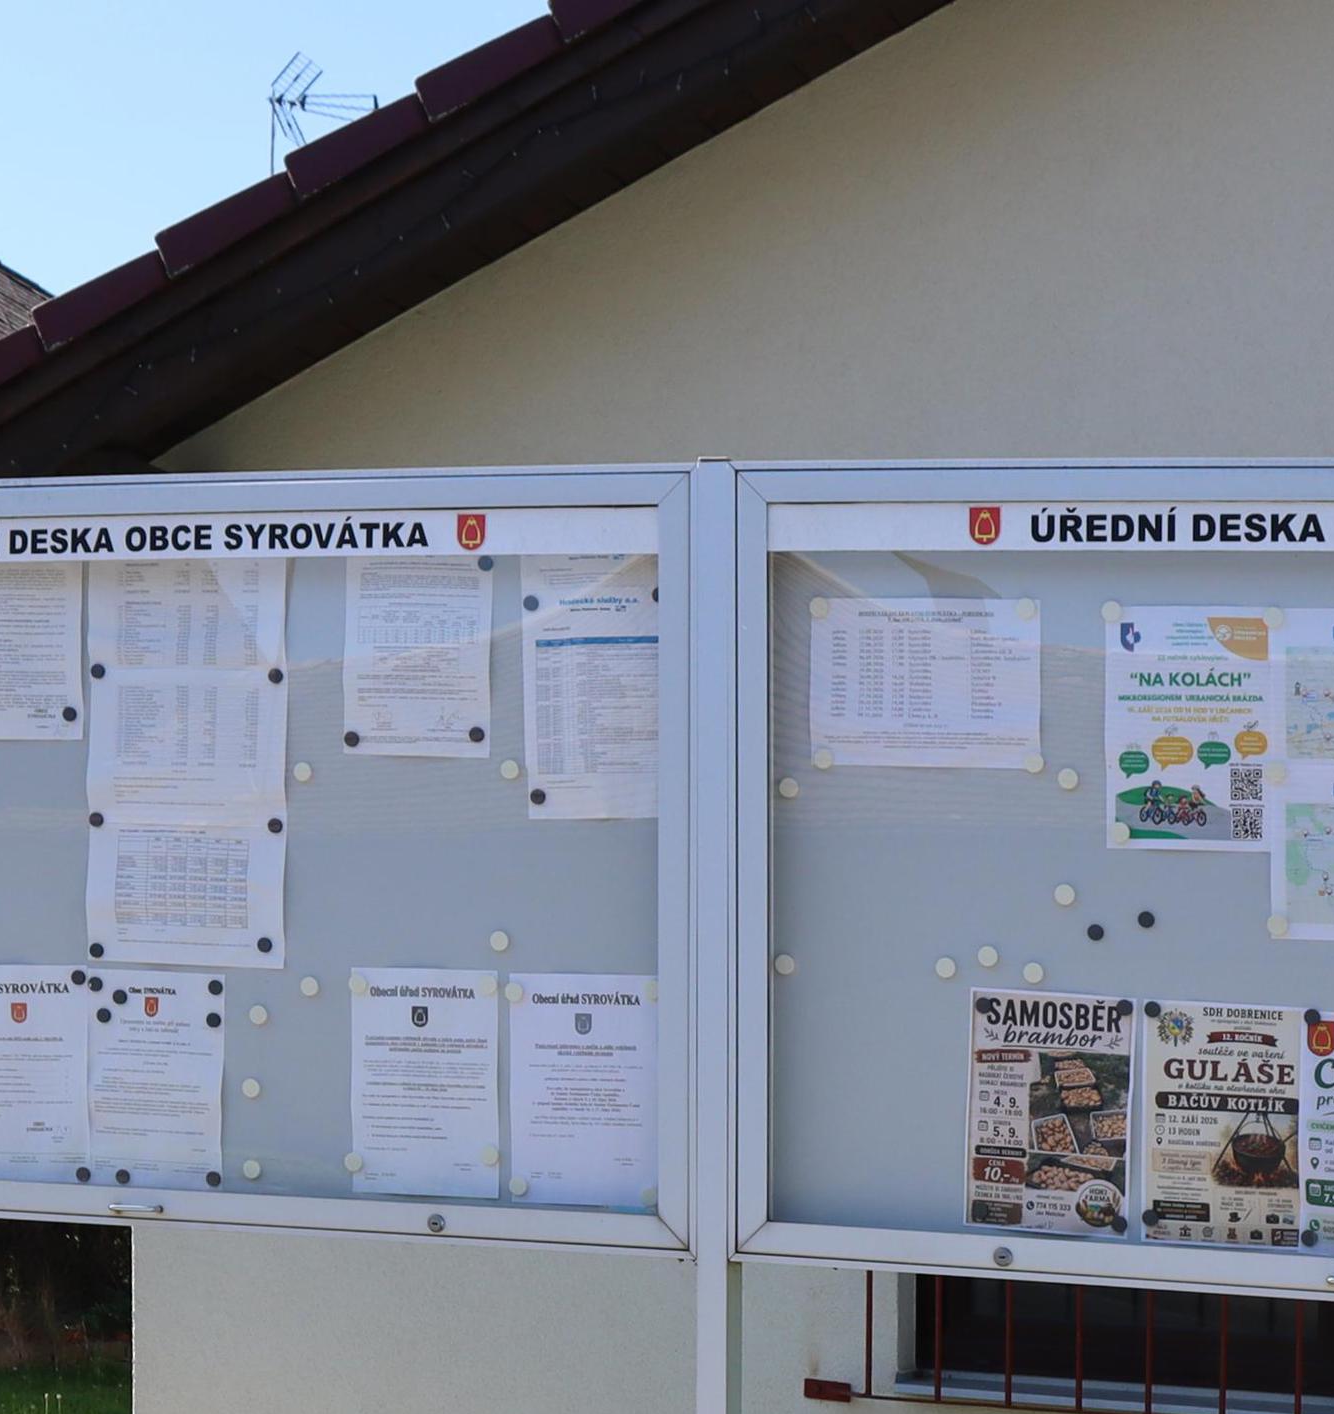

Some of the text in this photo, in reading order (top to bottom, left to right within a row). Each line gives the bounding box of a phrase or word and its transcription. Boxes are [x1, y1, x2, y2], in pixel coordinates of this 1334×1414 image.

[1030, 506, 1177, 543] ÚŘEDNÍ
[1193, 514, 1326, 543] DESKA
[9, 527, 113, 554] DESKA
[125, 525, 212, 551] OBCE
[224, 516, 429, 549] SYROVÁTKA
[1118, 694, 1182, 702] MIKROREGIONEM
[370, 985, 475, 1000] Obecní úřad SYROVÁTKA
[532, 992, 641, 1006] Obecní úřad SYROVÁTKA
[987, 997, 1122, 1033] SAMOSBĚR
[1202, 1007, 1223, 1018] SDH
[1003, 1023, 1102, 1048] brambor
[1234, 1032, 1264, 1043] ROČNÍK
[1163, 1058, 1295, 1086] GULÁŠE
[993, 1096, 1019, 1109] 4. 9.
[1167, 1090, 1285, 1112] BAČŮV KOTLÍK
[1180, 1114, 1198, 1124] ZÁŘÍ
[1200, 1116, 1219, 1125] 2026
[992, 1126, 1019, 1138] 5. 9.
[1178, 1127, 1200, 1136] HODIN
[988, 1159, 1006, 1167] CENA
